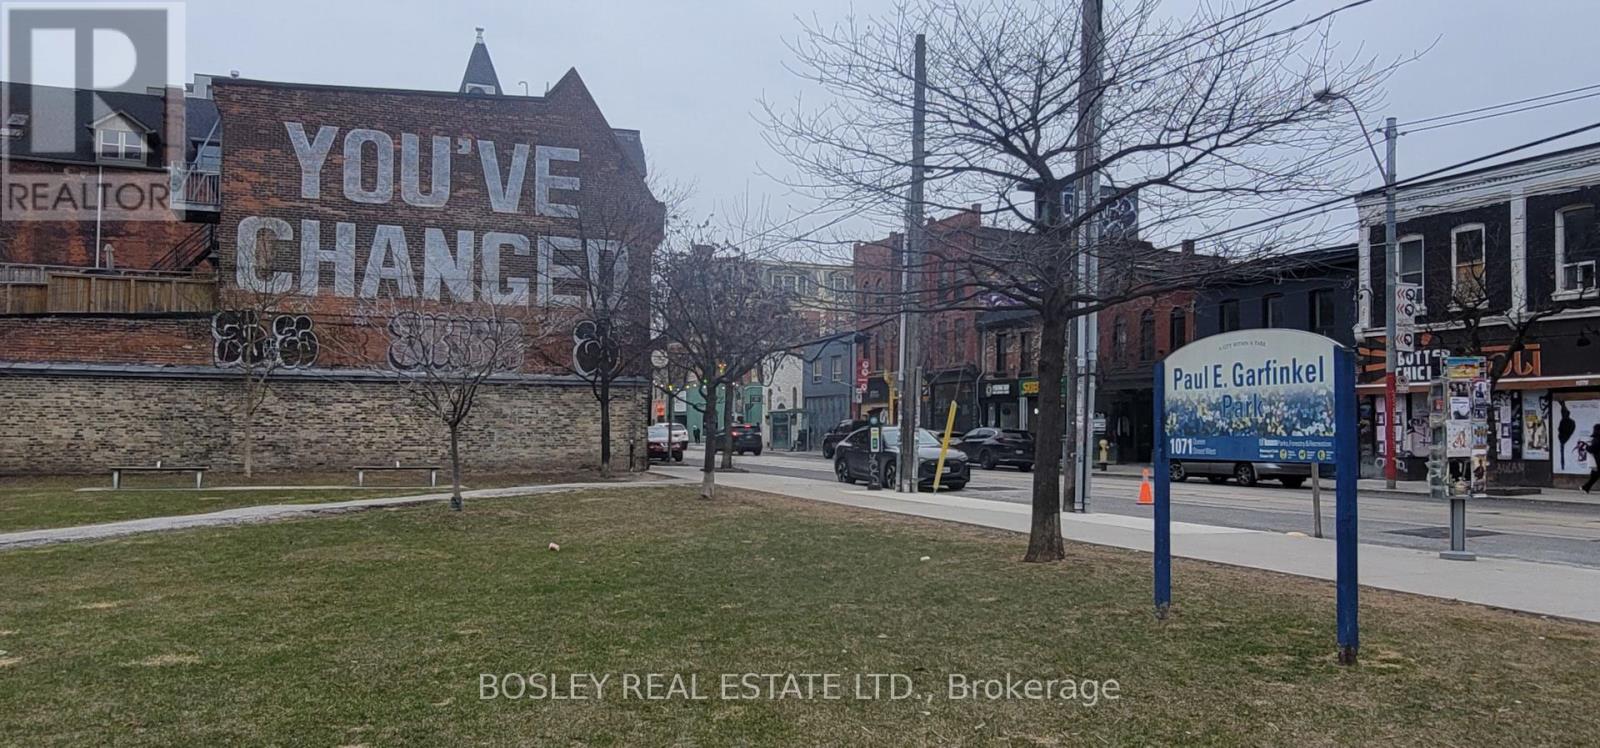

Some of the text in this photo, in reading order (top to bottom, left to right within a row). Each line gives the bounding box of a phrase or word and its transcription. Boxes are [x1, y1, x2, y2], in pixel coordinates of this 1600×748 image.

[284, 122, 580, 218] YOU'VE
[236, 215, 630, 308] CHANGED
[1174, 355, 1324, 390] Paul E. Garfinkel
[1222, 394, 1264, 418] Park
[1169, 438, 1192, 455] 1071
